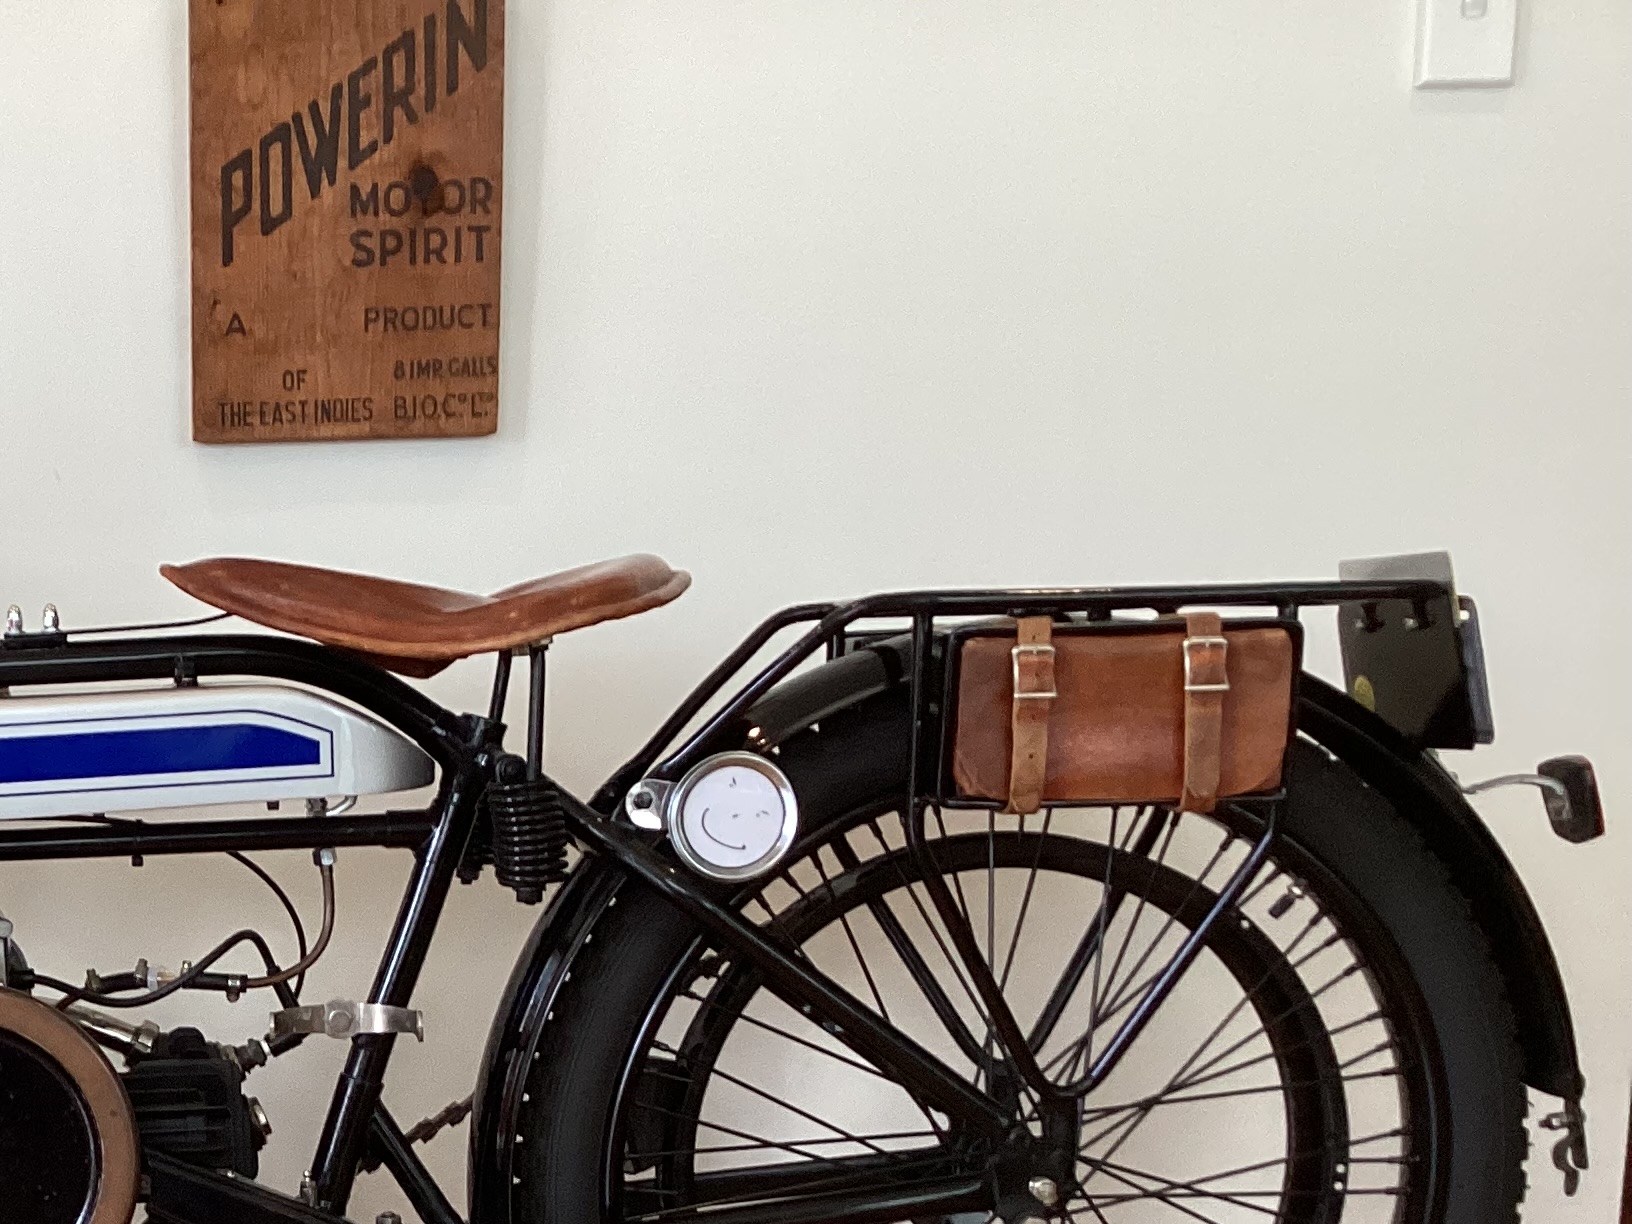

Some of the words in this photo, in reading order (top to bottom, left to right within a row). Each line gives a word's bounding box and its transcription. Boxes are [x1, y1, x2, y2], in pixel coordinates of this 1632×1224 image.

[220, 0, 488, 267] POWERIN
[350, 225, 491, 268] SPIRIT
[225, 311, 247, 337] A
[364, 303, 492, 333] PRODUCT
[282, 369, 307, 392] OF
[219, 401, 253, 428] THE
[259, 400, 308, 426] EAST
[314, 397, 373, 425] INDIES
